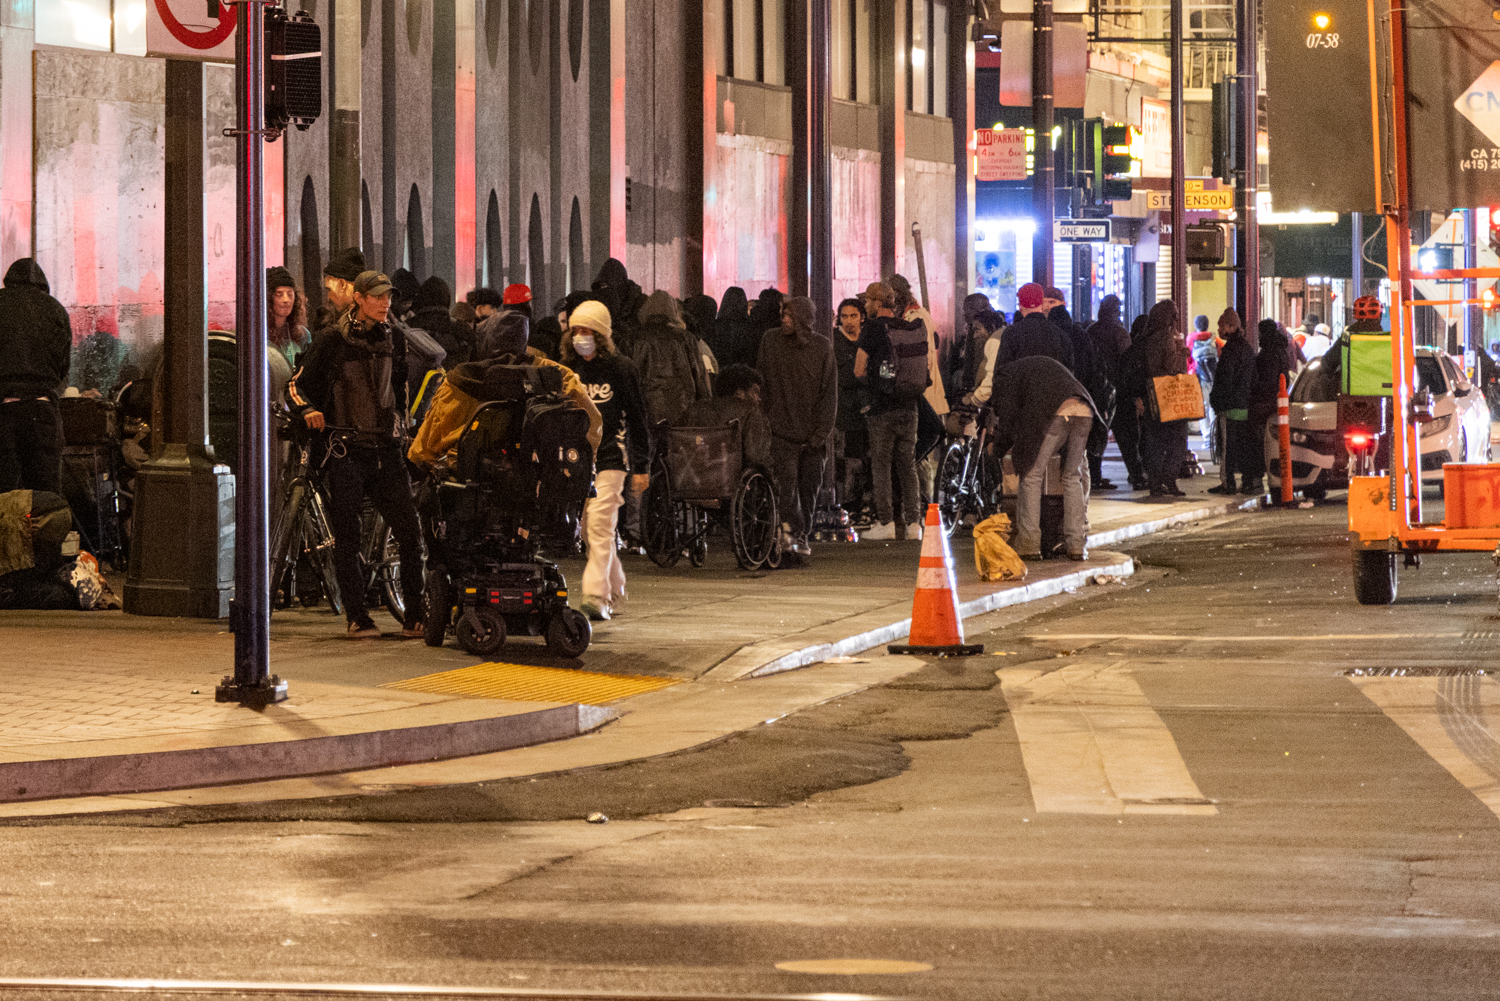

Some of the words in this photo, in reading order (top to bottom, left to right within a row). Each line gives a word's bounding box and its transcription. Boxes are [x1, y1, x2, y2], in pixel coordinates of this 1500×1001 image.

[1306, 32, 1340, 49] 07-58
[978, 131, 992, 144] NO
[993, 134, 1025, 144] PARKING
[1470, 148, 1488, 159] CA
[1460, 159, 1488, 172] (415)
[1152, 195, 1227, 206] STEENSON
[1060, 227, 1079, 236] ONE
[1082, 226, 1103, 236] WAY
